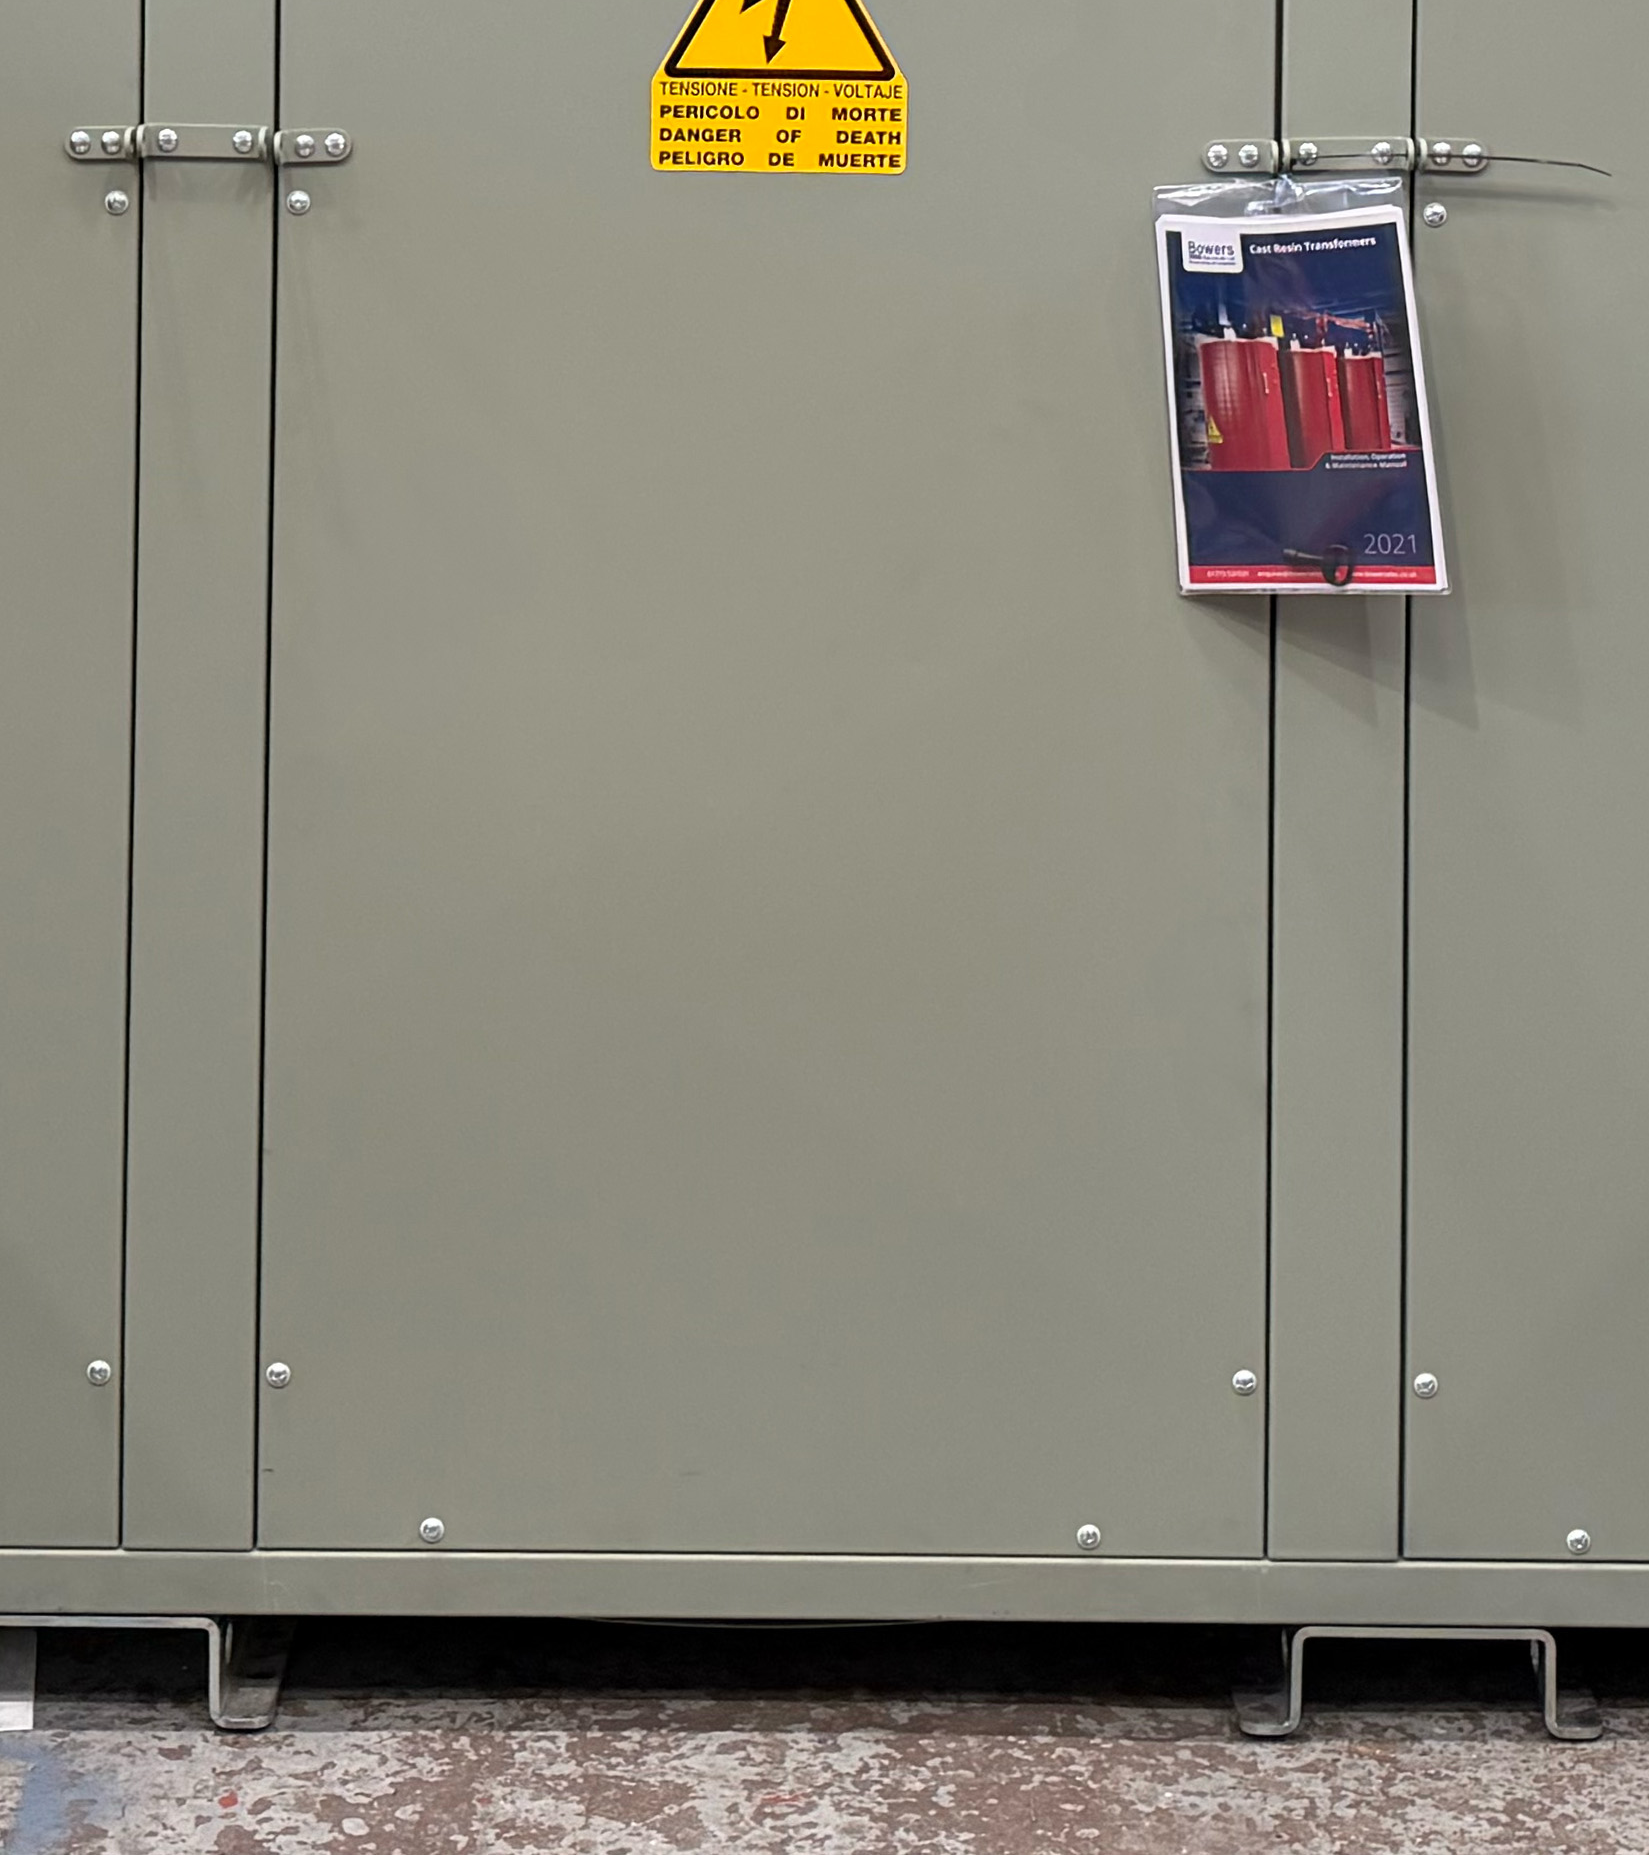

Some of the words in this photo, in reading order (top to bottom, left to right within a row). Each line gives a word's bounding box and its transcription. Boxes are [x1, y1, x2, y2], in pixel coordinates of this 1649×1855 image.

[660, 81, 737, 95] TENSIONE
[753, 82, 819, 97] TENSION
[834, 84, 903, 99] VOLTAJE
[660, 105, 759, 119] PERICOLO
[786, 107, 805, 120] DI
[832, 107, 902, 121] MORTE
[660, 128, 741, 142] DANGER
[776, 129, 802, 143] OF
[836, 131, 901, 145] DEATH
[659, 151, 744, 165] PELIGRO
[769, 153, 794, 166] DE
[819, 153, 901, 168] MUERTE
[1188, 241, 1234, 255] Bowers
[1250, 244, 1272, 254] Cast
[1273, 242, 1302, 253] Resin
[1304, 237, 1376, 252] Transformers
[1363, 533, 1417, 555] 2021
